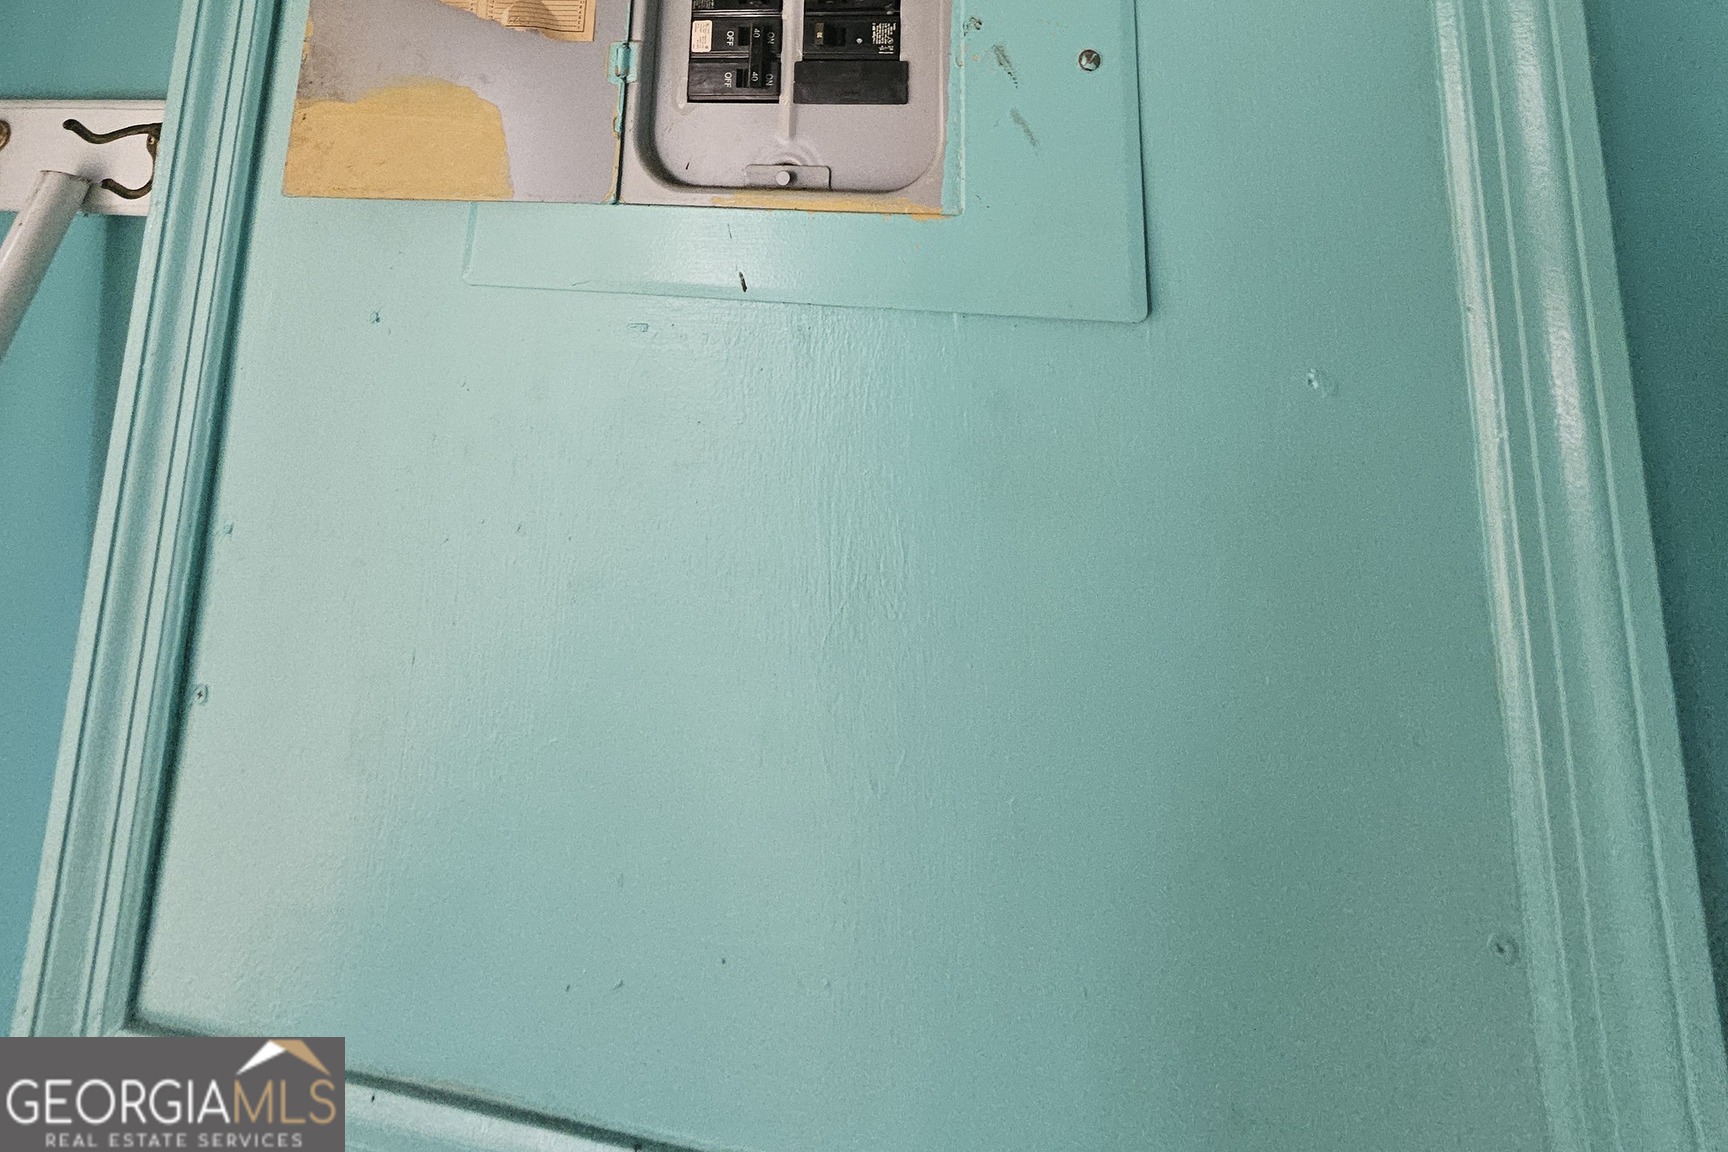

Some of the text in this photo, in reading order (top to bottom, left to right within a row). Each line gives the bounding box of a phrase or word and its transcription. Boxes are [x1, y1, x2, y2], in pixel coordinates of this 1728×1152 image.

[726, 31, 735, 46] OFF
[753, 28, 760, 38] 40
[767, 32, 775, 44] ON
[724, 72, 732, 88] OFF
[751, 71, 759, 82] 40
[766, 74, 774, 87] ON
